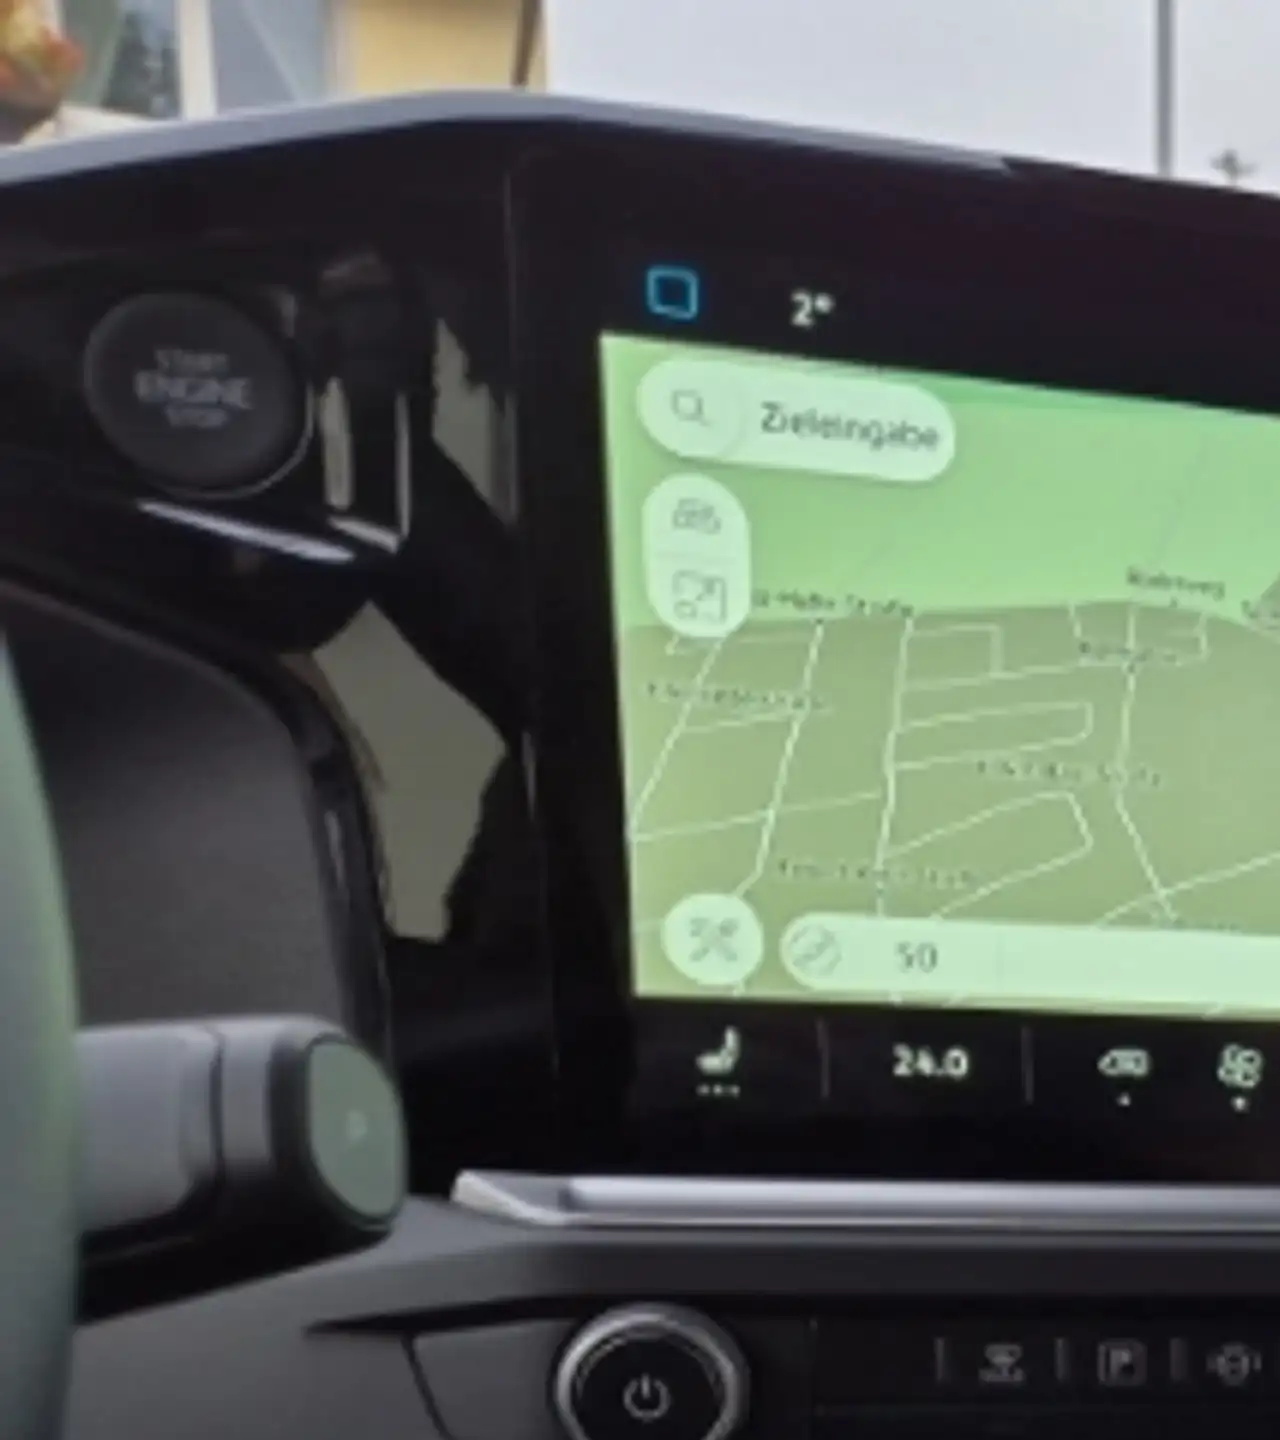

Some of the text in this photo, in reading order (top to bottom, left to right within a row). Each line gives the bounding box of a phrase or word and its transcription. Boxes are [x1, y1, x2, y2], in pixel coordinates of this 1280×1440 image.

[759, 401, 941, 451] Zieleingabe
[896, 940, 939, 974] 50
[891, 1043, 969, 1080] 24.0
